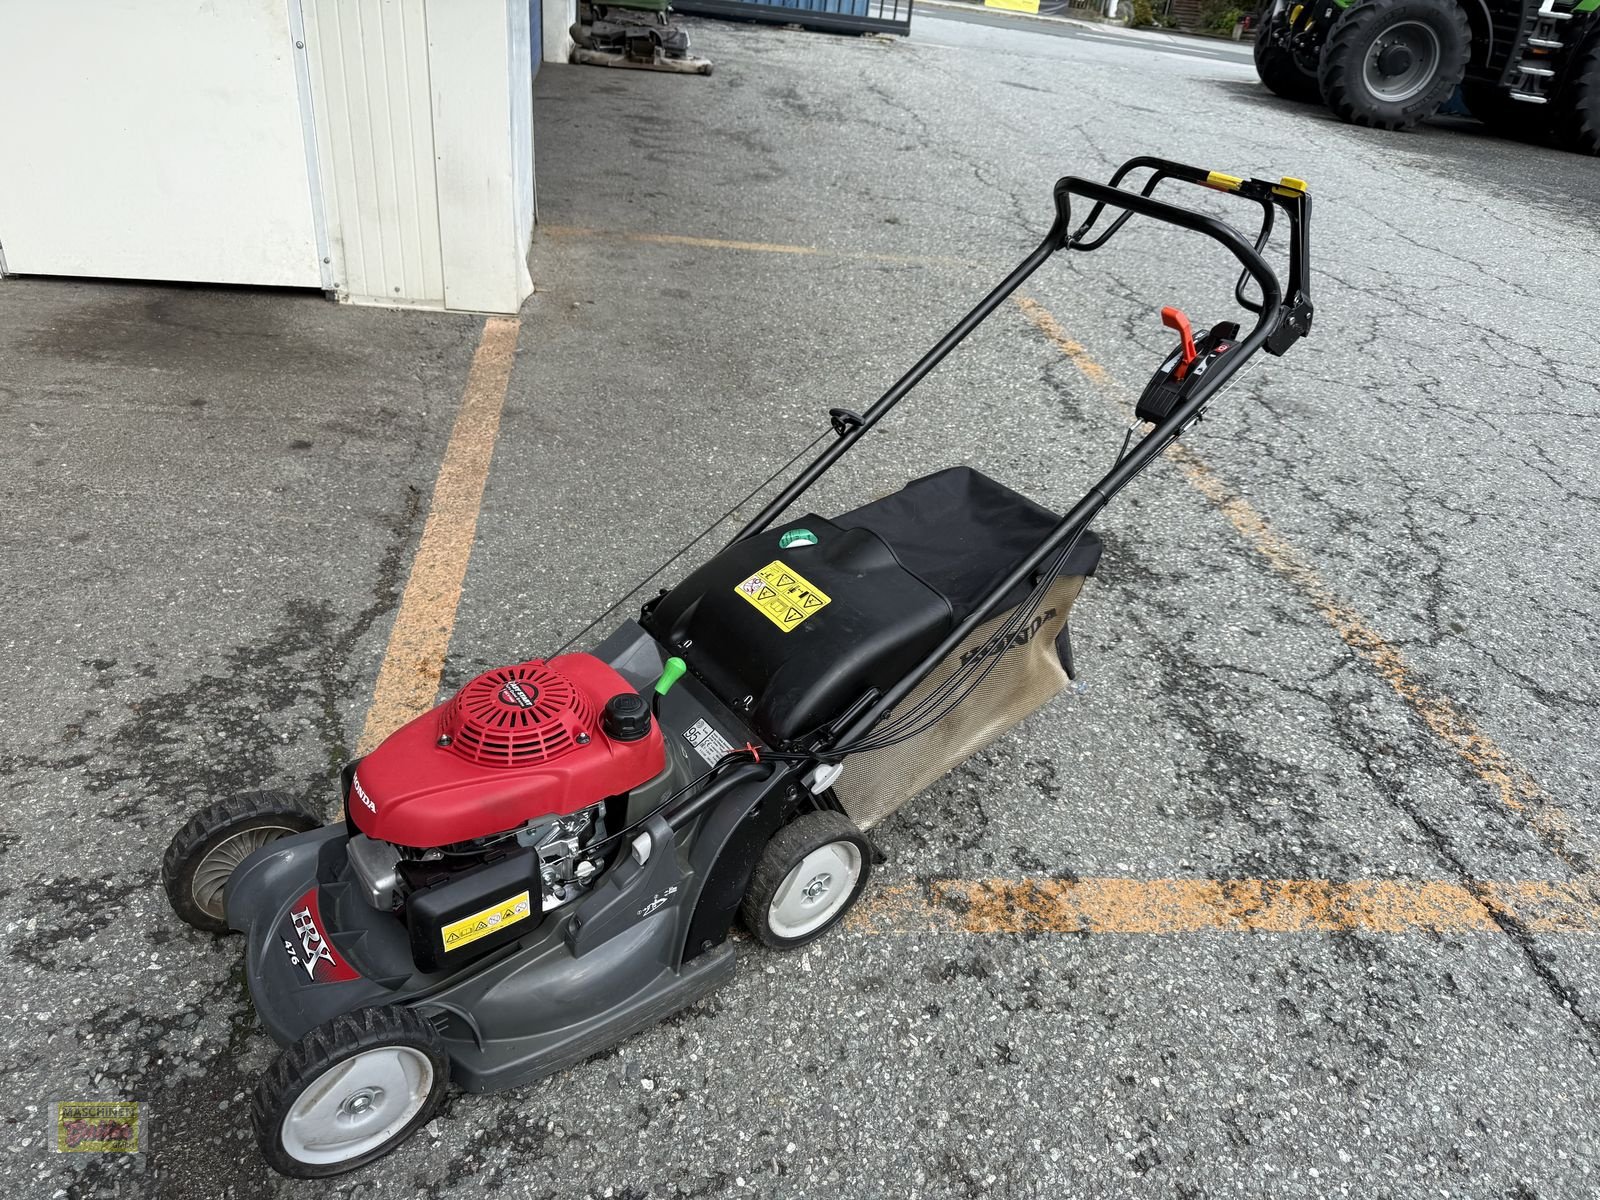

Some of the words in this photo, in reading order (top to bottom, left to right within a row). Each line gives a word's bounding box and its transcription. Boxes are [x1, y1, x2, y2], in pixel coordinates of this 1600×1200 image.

[685, 727, 701, 742] 95
[284, 940, 300, 966] 476
[290, 906, 336, 980] HRX
